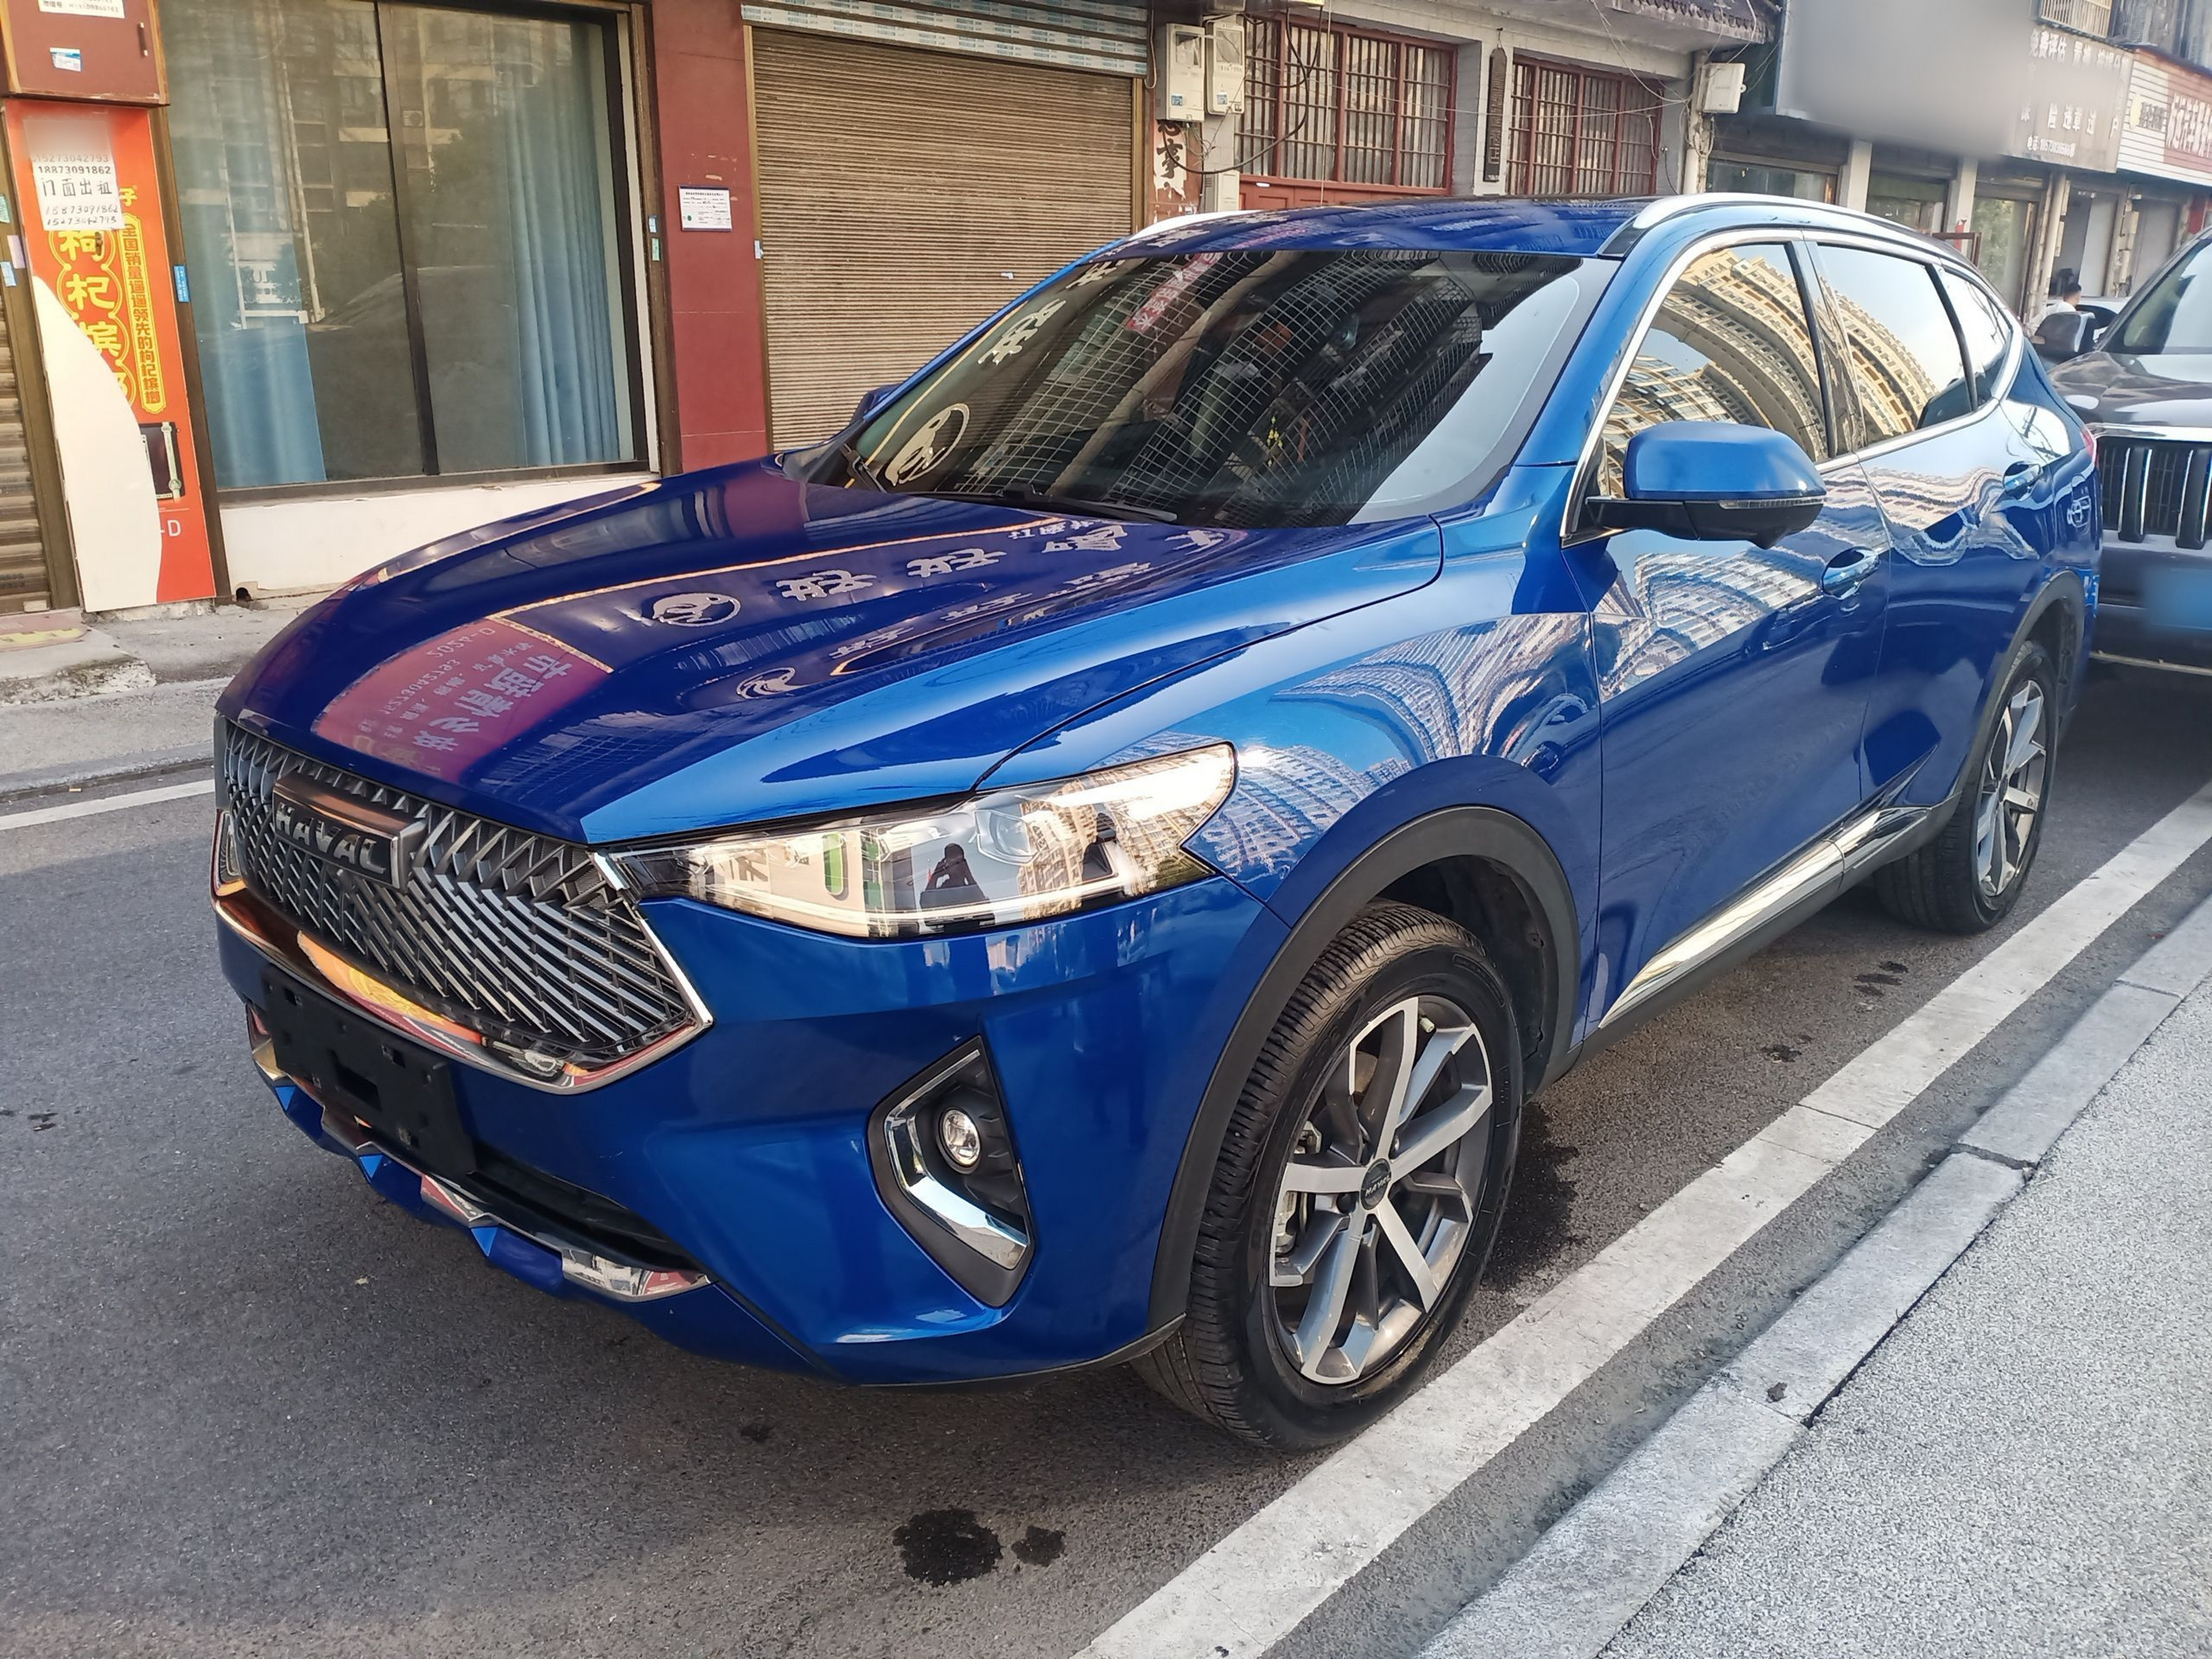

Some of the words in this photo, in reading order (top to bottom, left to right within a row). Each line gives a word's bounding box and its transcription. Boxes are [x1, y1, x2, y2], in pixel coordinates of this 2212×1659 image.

[38, 166, 111, 175] 18873091862
[41, 178, 112, 197] 门面出租
[58, 230, 128, 396] 枸杞槟
[276, 802, 387, 874] HAVAL
[1365, 1175, 1391, 1196] HAVAL
